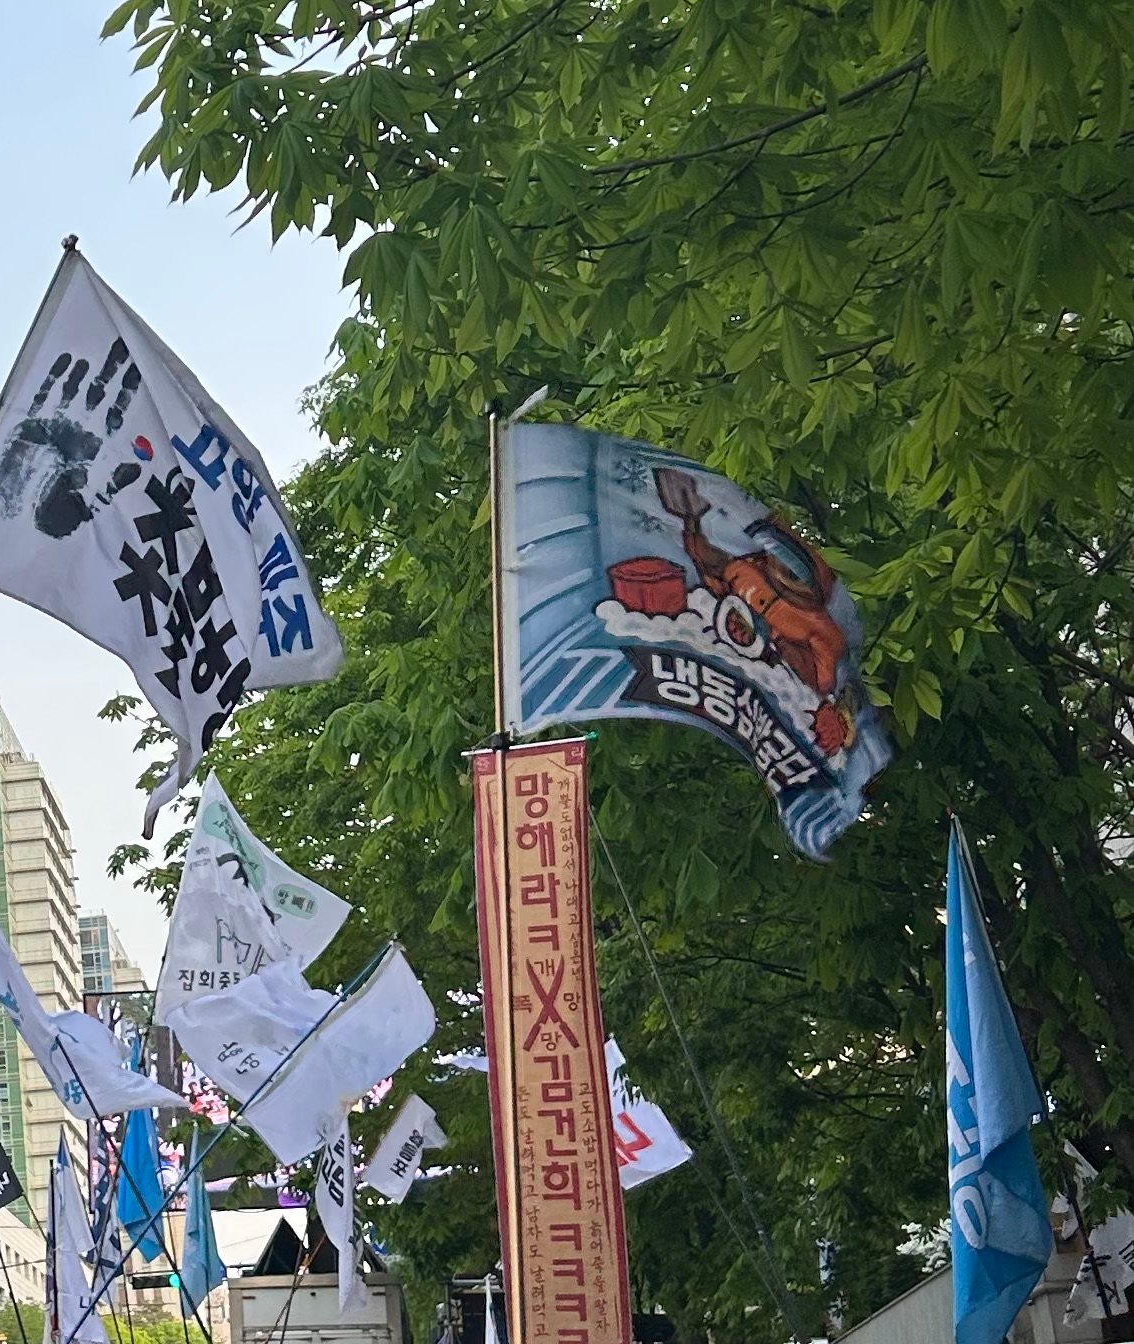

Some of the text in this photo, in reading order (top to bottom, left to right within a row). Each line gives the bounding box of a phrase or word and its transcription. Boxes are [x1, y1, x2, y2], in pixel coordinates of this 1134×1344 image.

[534, 958, 555, 977] 개
[563, 992, 581, 1012] 망
[540, 1031, 563, 1052] 망
[533, 1054, 582, 1211] 김건희
